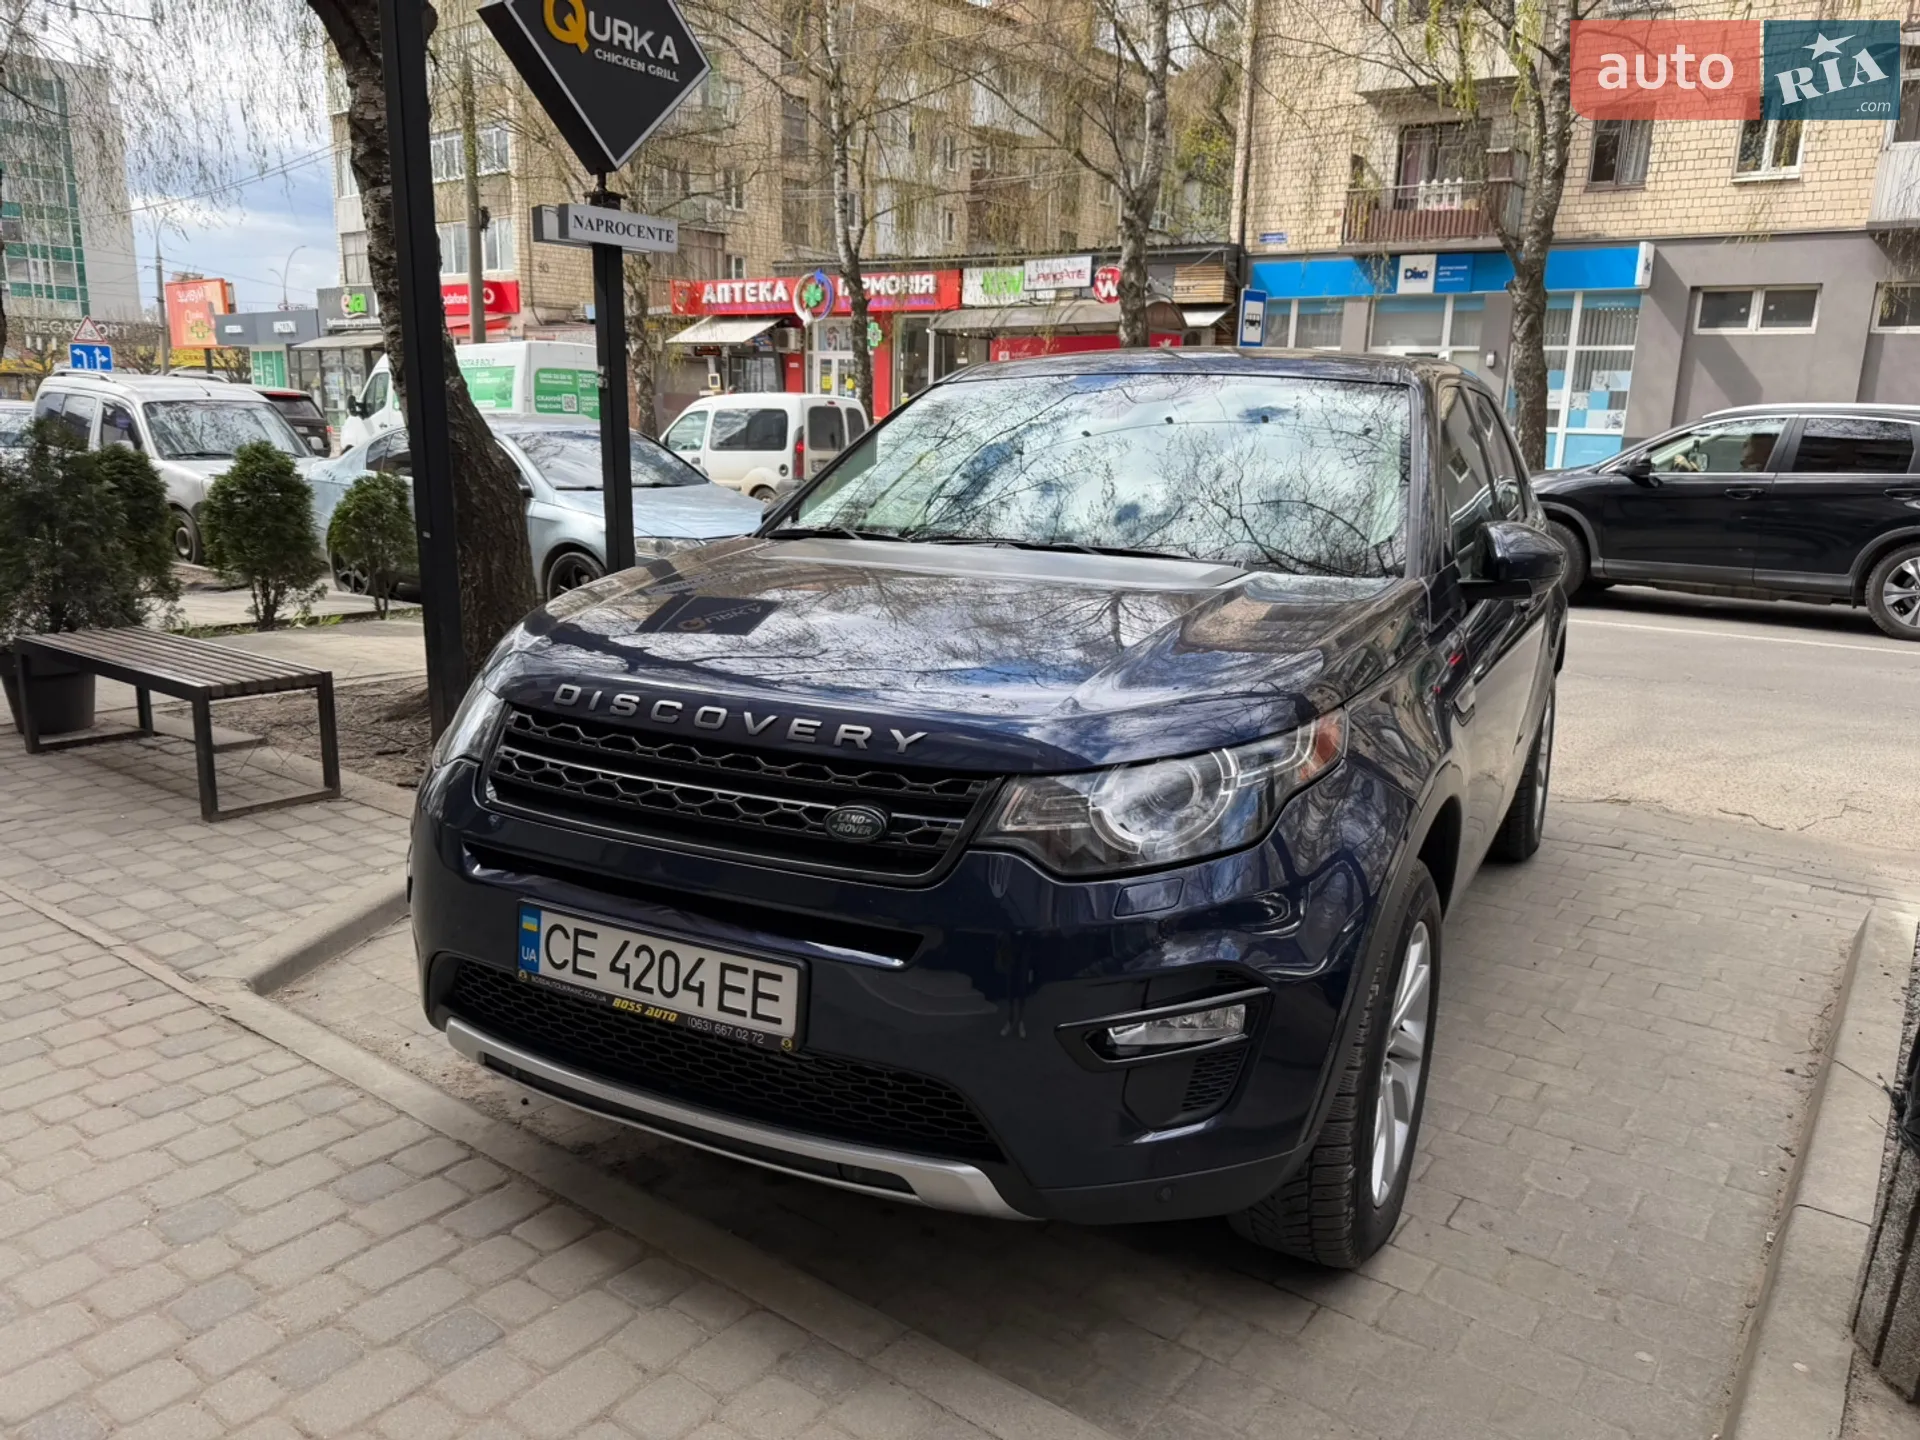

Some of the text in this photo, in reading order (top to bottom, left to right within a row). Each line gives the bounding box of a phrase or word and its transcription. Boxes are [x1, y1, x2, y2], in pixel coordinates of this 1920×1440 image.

[544, 0, 680, 64] QURKA
[593, 48, 680, 83] CHICKEN GRILL
[572, 214, 676, 244] NAPROCENTE
[443, 293, 468, 305] odafone
[702, 274, 937, 304] АПТЕКА ГРМОНІЯ
[24, 319, 131, 338] MEGASORT
[553, 683, 928, 754] DISCOVERY
[521, 946, 537, 963] UA
[544, 923, 783, 1025] CE 4204 EE
[612, 997, 678, 1023] BOSS AUTO
[687, 1016, 764, 1044] (063) 667 02 72
